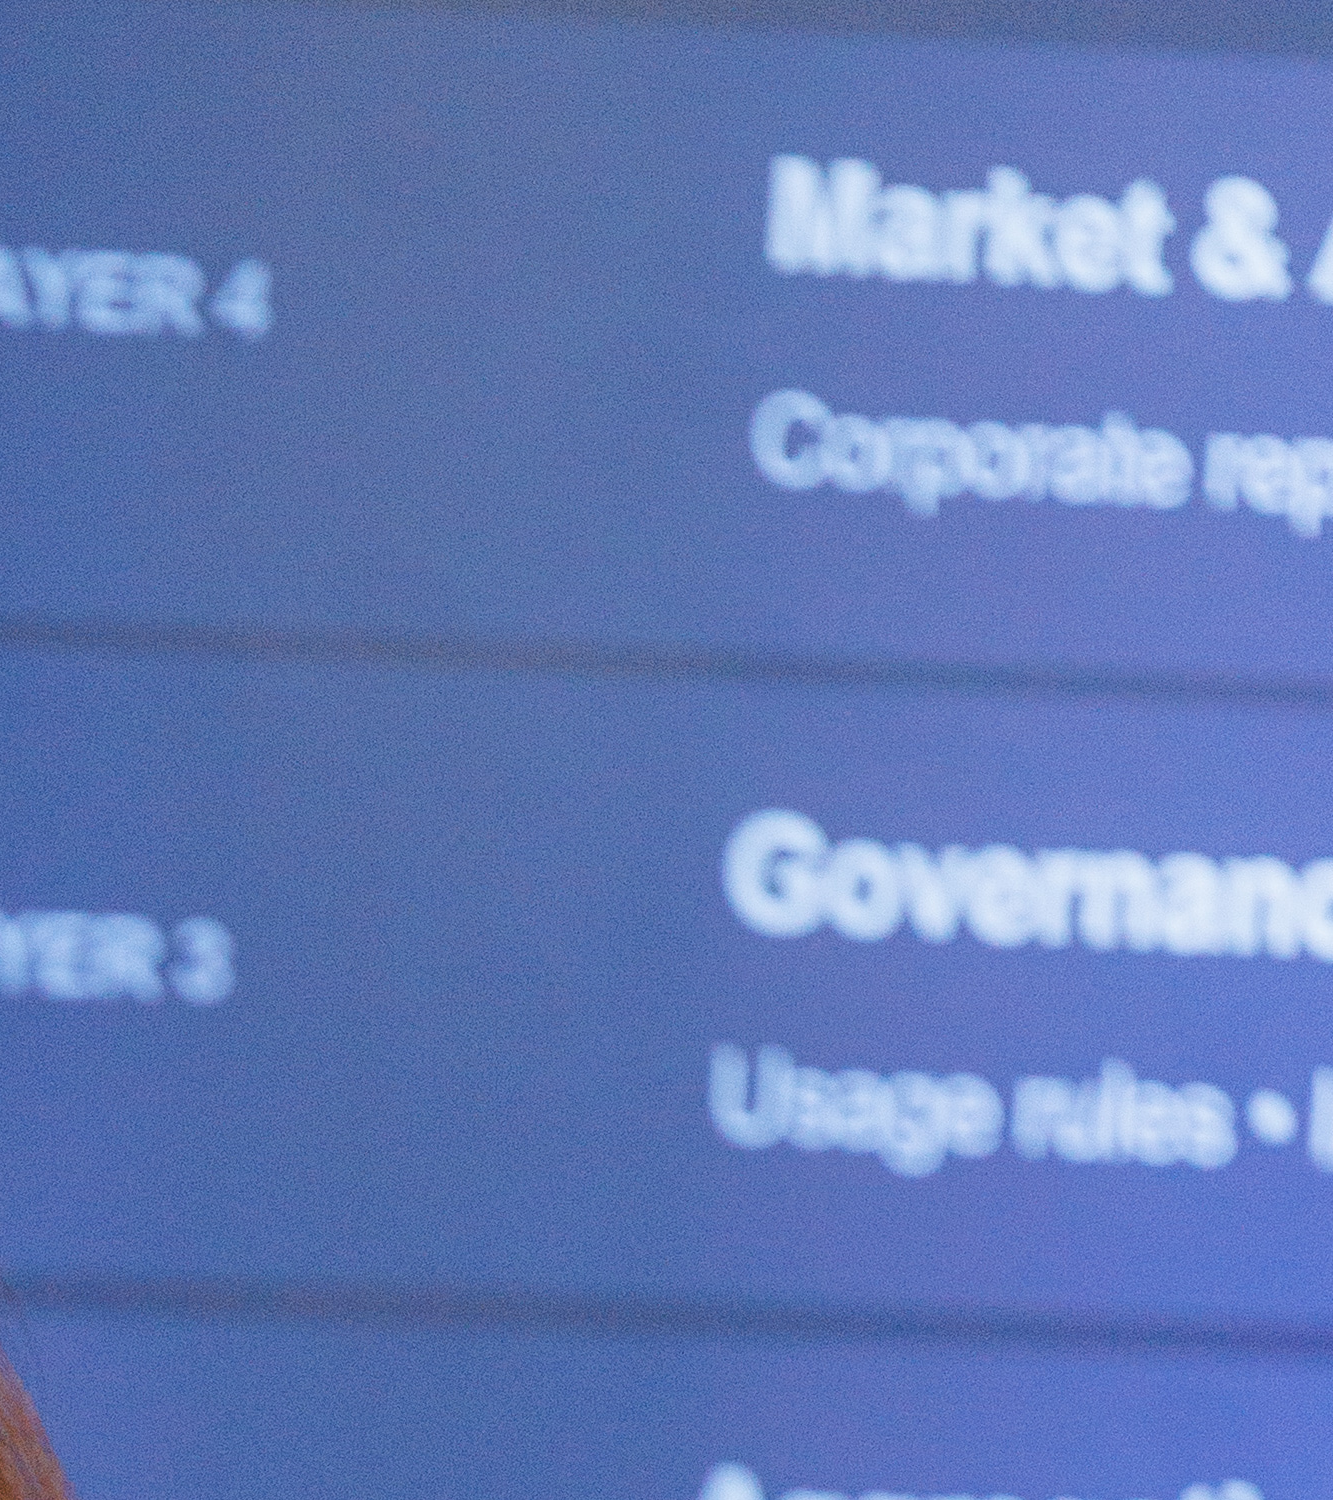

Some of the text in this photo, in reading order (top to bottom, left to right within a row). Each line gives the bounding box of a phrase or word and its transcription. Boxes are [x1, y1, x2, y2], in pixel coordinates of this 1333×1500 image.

[764, 152, 1175, 297] Market
[1190, 175, 1292, 300] &
[215, 258, 273, 337] 4
[751, 387, 1193, 518] Corporate
[168, 917, 236, 1003] 3
[708, 1042, 1005, 1179] Usage
[1012, 1054, 1238, 1171] rules
